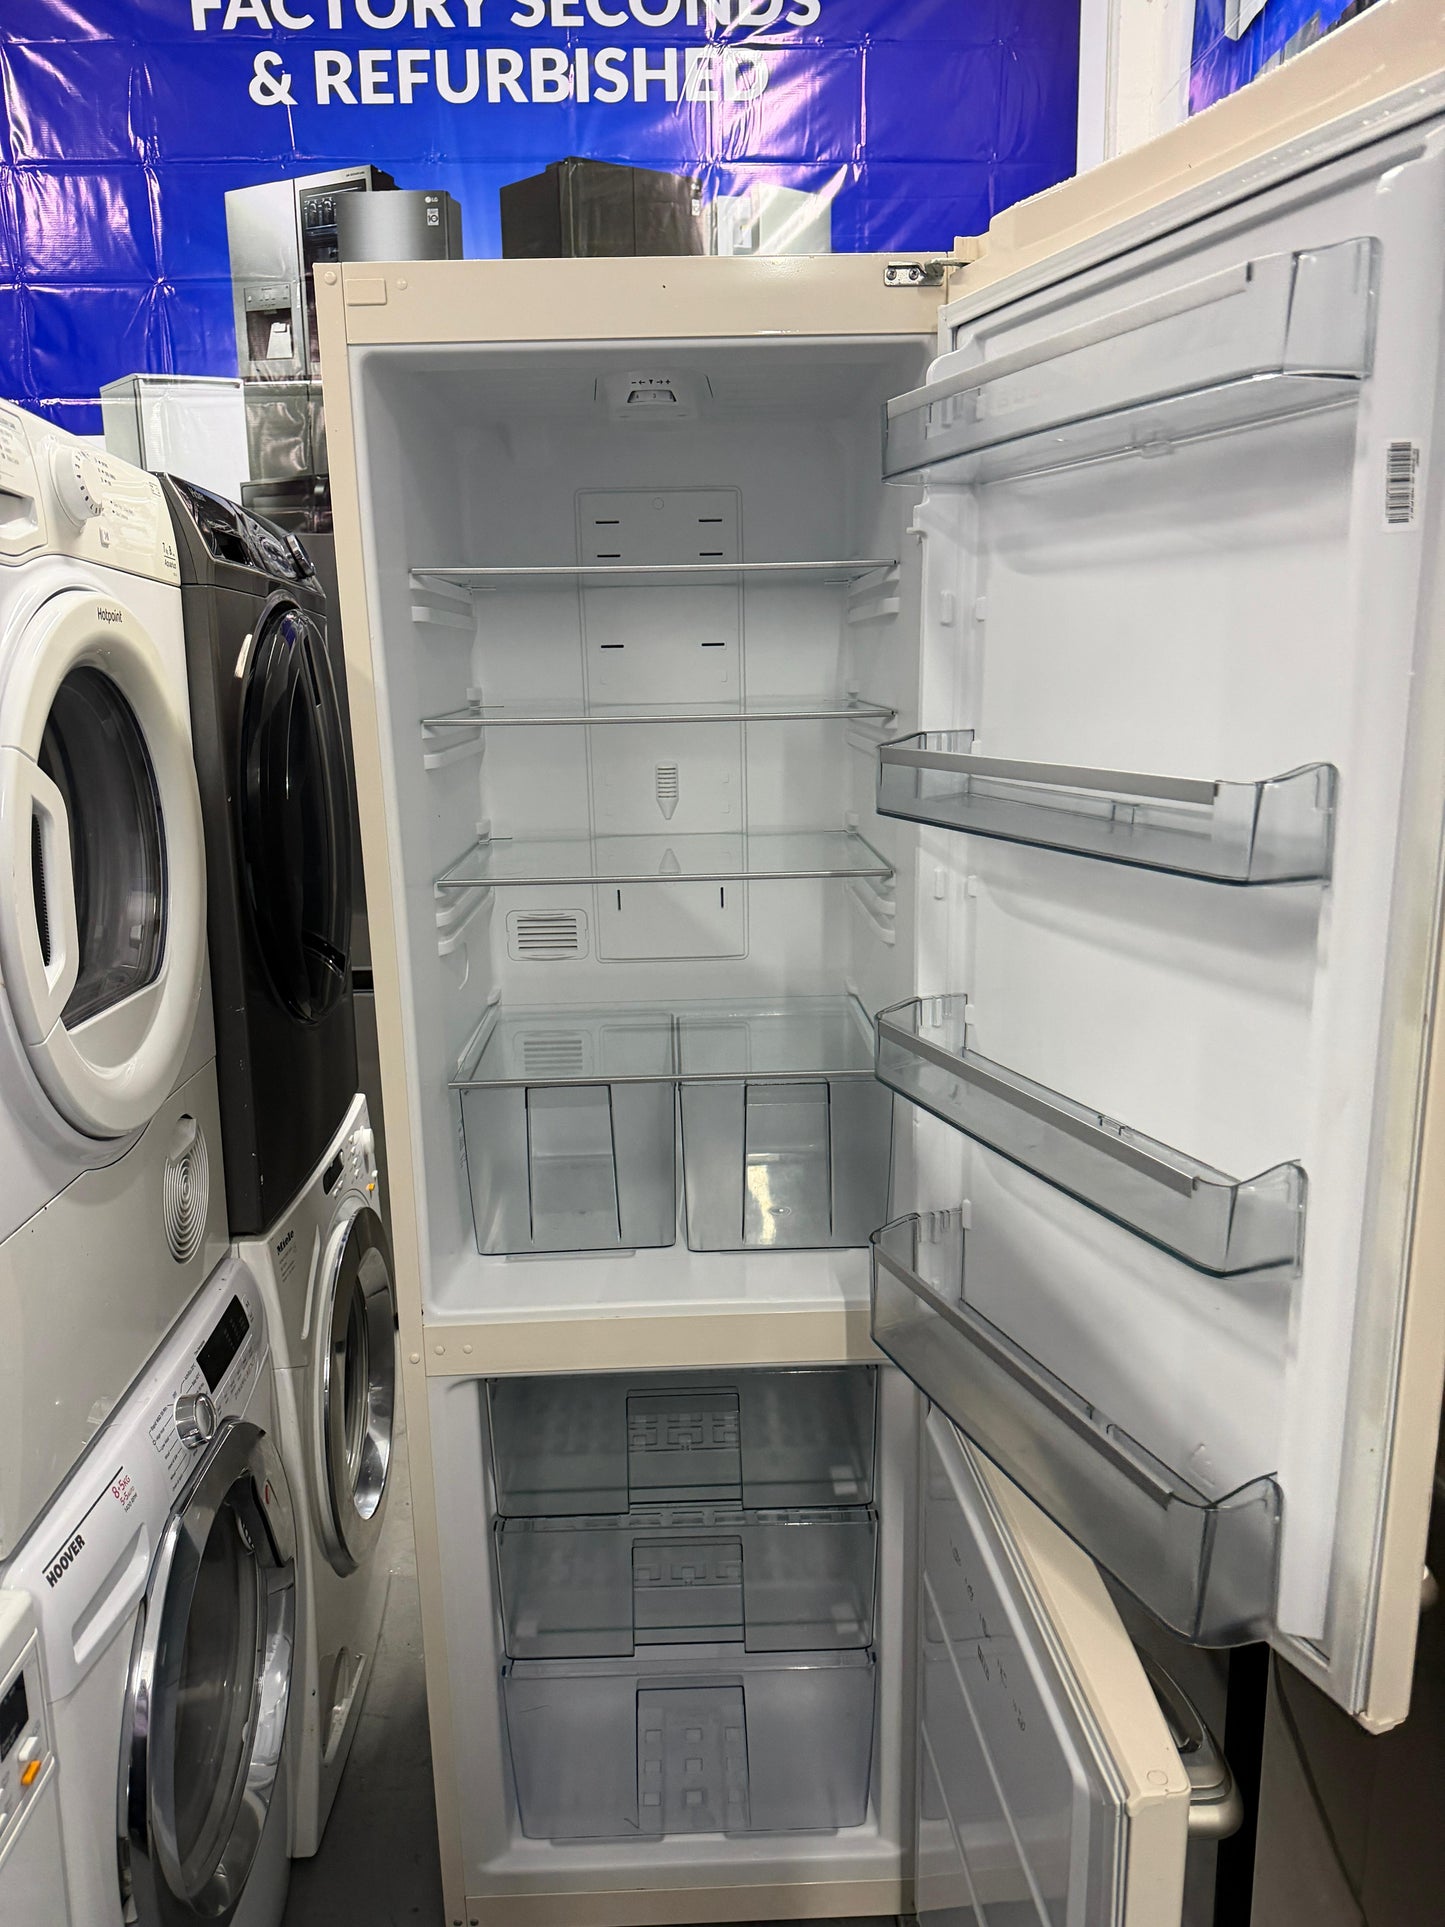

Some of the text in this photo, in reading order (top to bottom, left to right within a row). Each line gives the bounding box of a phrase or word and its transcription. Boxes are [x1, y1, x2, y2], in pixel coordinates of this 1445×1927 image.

[248, 47, 769, 106] & REFURBISHED
[97, 606, 123, 625] Hotpoint
[276, 1230, 294, 1256] Miele
[45, 1534, 86, 1588] HOOVER
